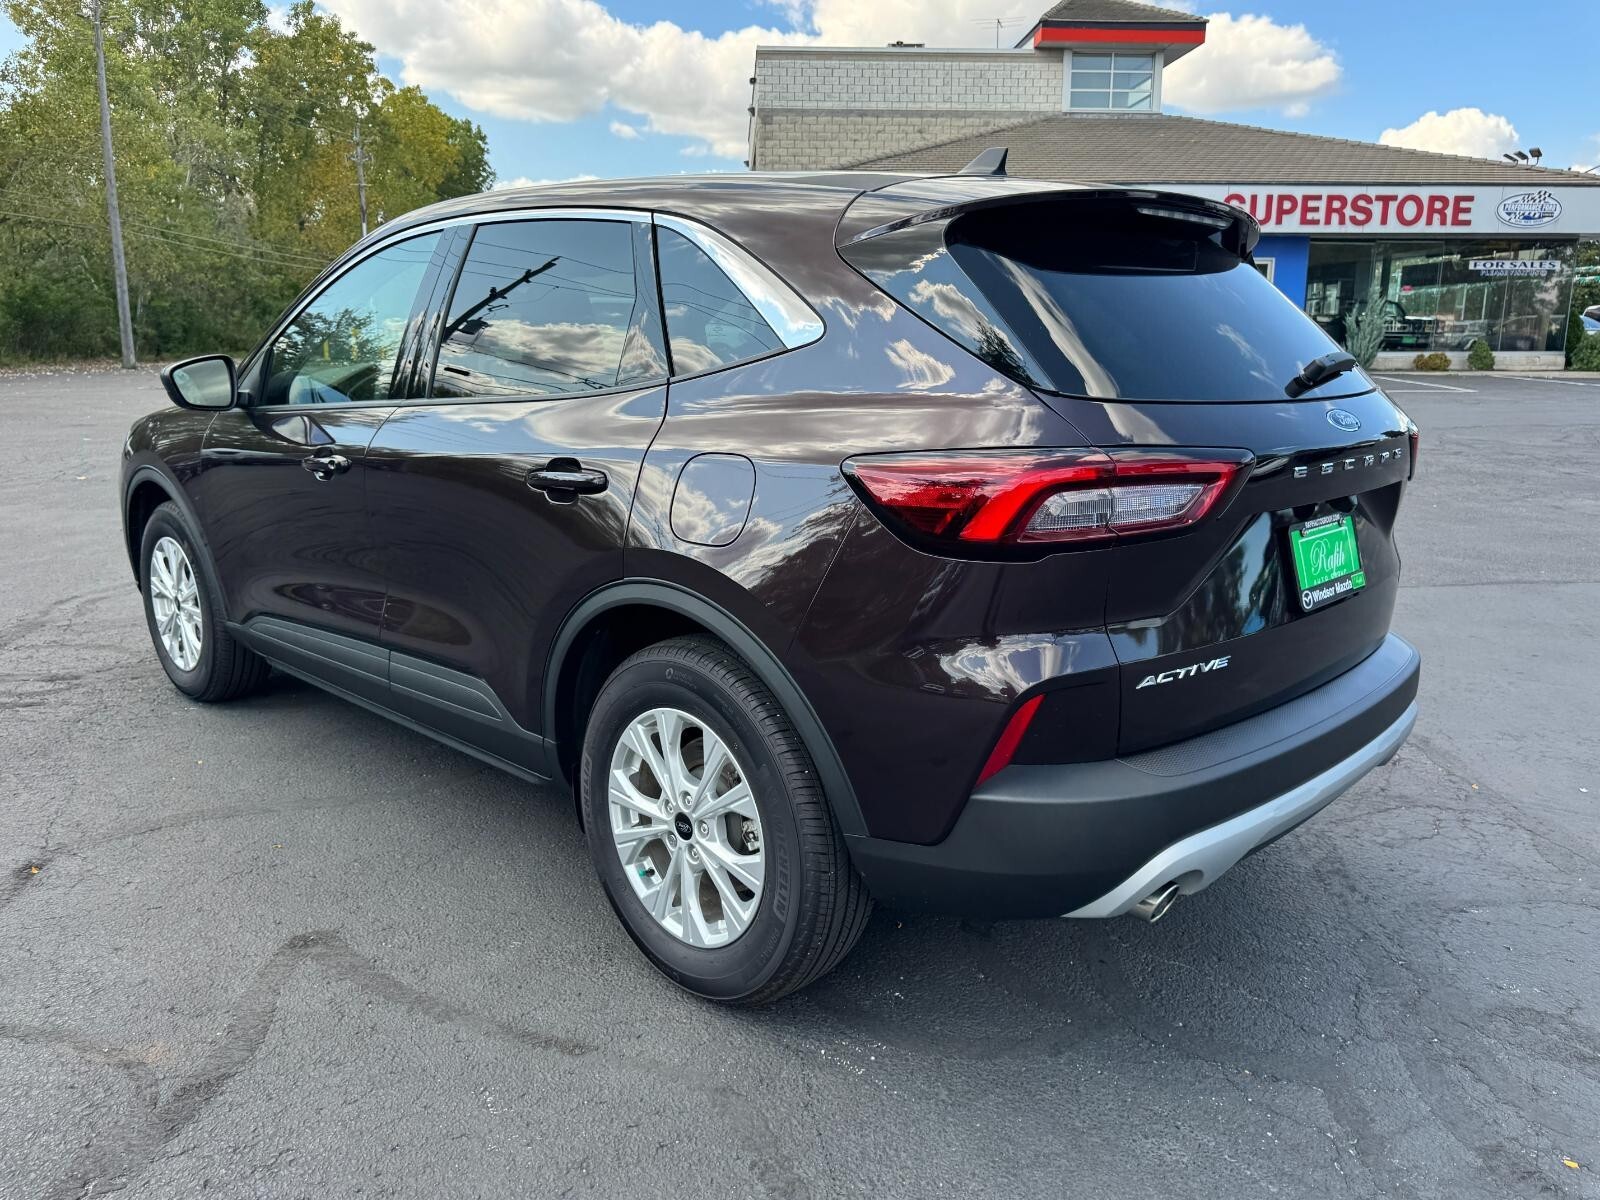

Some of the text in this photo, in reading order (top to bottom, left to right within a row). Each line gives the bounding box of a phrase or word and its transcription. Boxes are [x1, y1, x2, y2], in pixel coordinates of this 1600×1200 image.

[1473, 261, 1556, 269] FOR SALES
[1293, 447, 1402, 479] ESCAPE
[1311, 584, 1335, 603] Windsor
[1334, 579, 1353, 594] Mazda
[1136, 655, 1232, 690] ACTIVE
